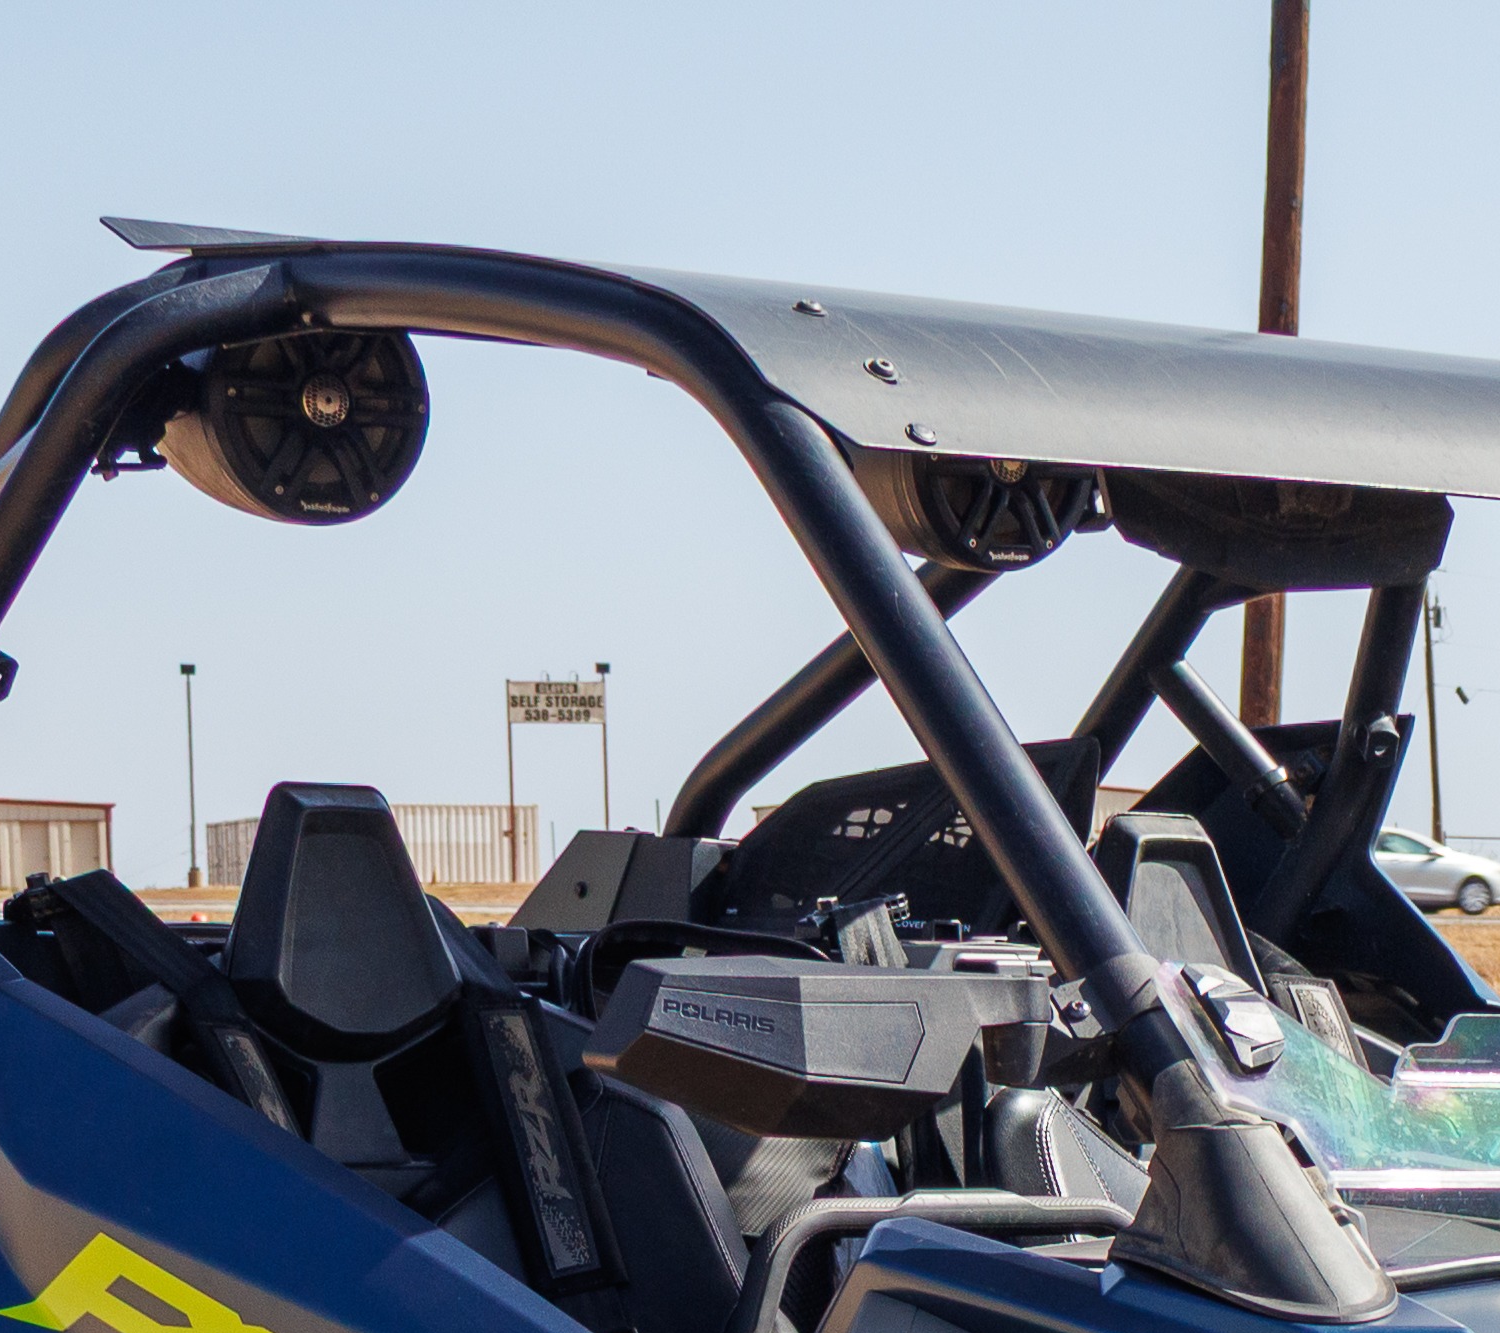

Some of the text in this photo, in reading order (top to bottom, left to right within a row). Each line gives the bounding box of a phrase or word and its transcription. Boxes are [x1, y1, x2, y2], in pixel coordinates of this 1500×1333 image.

[510, 696, 603, 708] SELF STORAGE
[662, 997, 775, 1034] POLARIS
[508, 1070, 574, 1200] RZR
